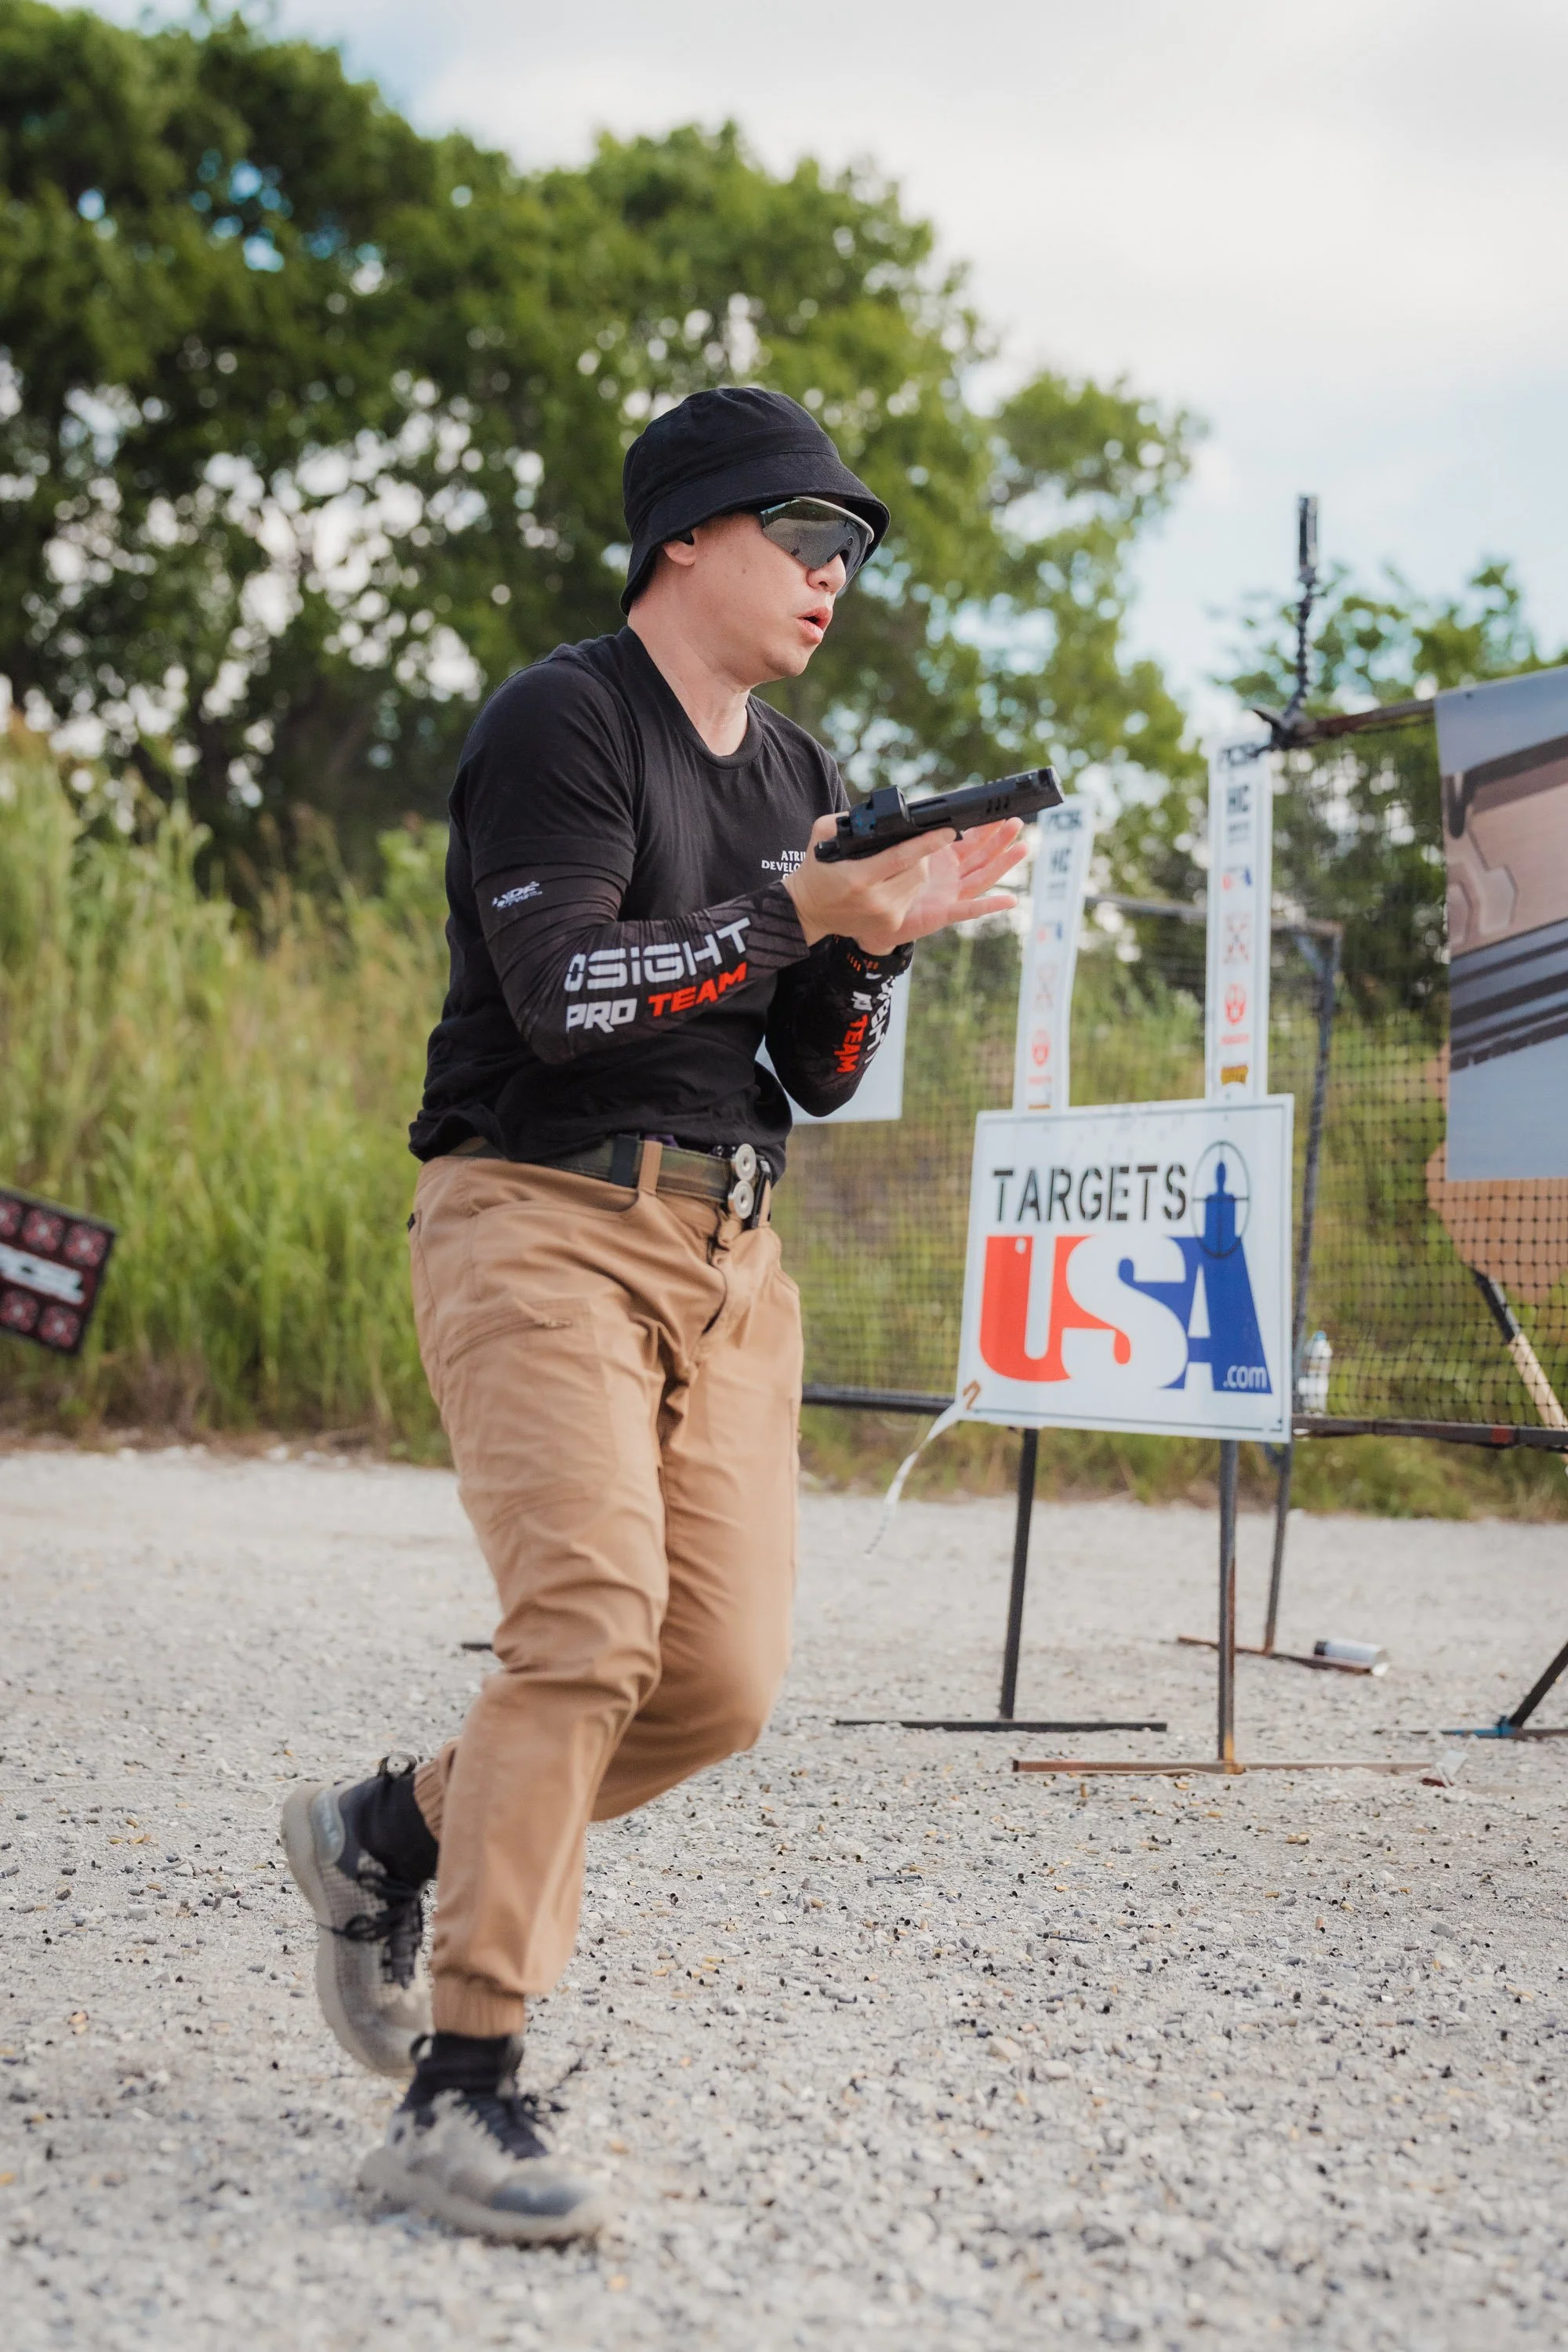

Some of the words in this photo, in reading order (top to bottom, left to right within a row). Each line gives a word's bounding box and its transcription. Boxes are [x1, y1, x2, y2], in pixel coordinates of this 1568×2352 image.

[565, 997, 638, 1034] PRO
[648, 961, 748, 1018] TEAM
[834, 1014, 869, 1073] TEAM
[993, 1163, 1187, 1222] TARGETS
[978, 1233, 1273, 1395] USA
[1222, 1365, 1268, 1389] .com
